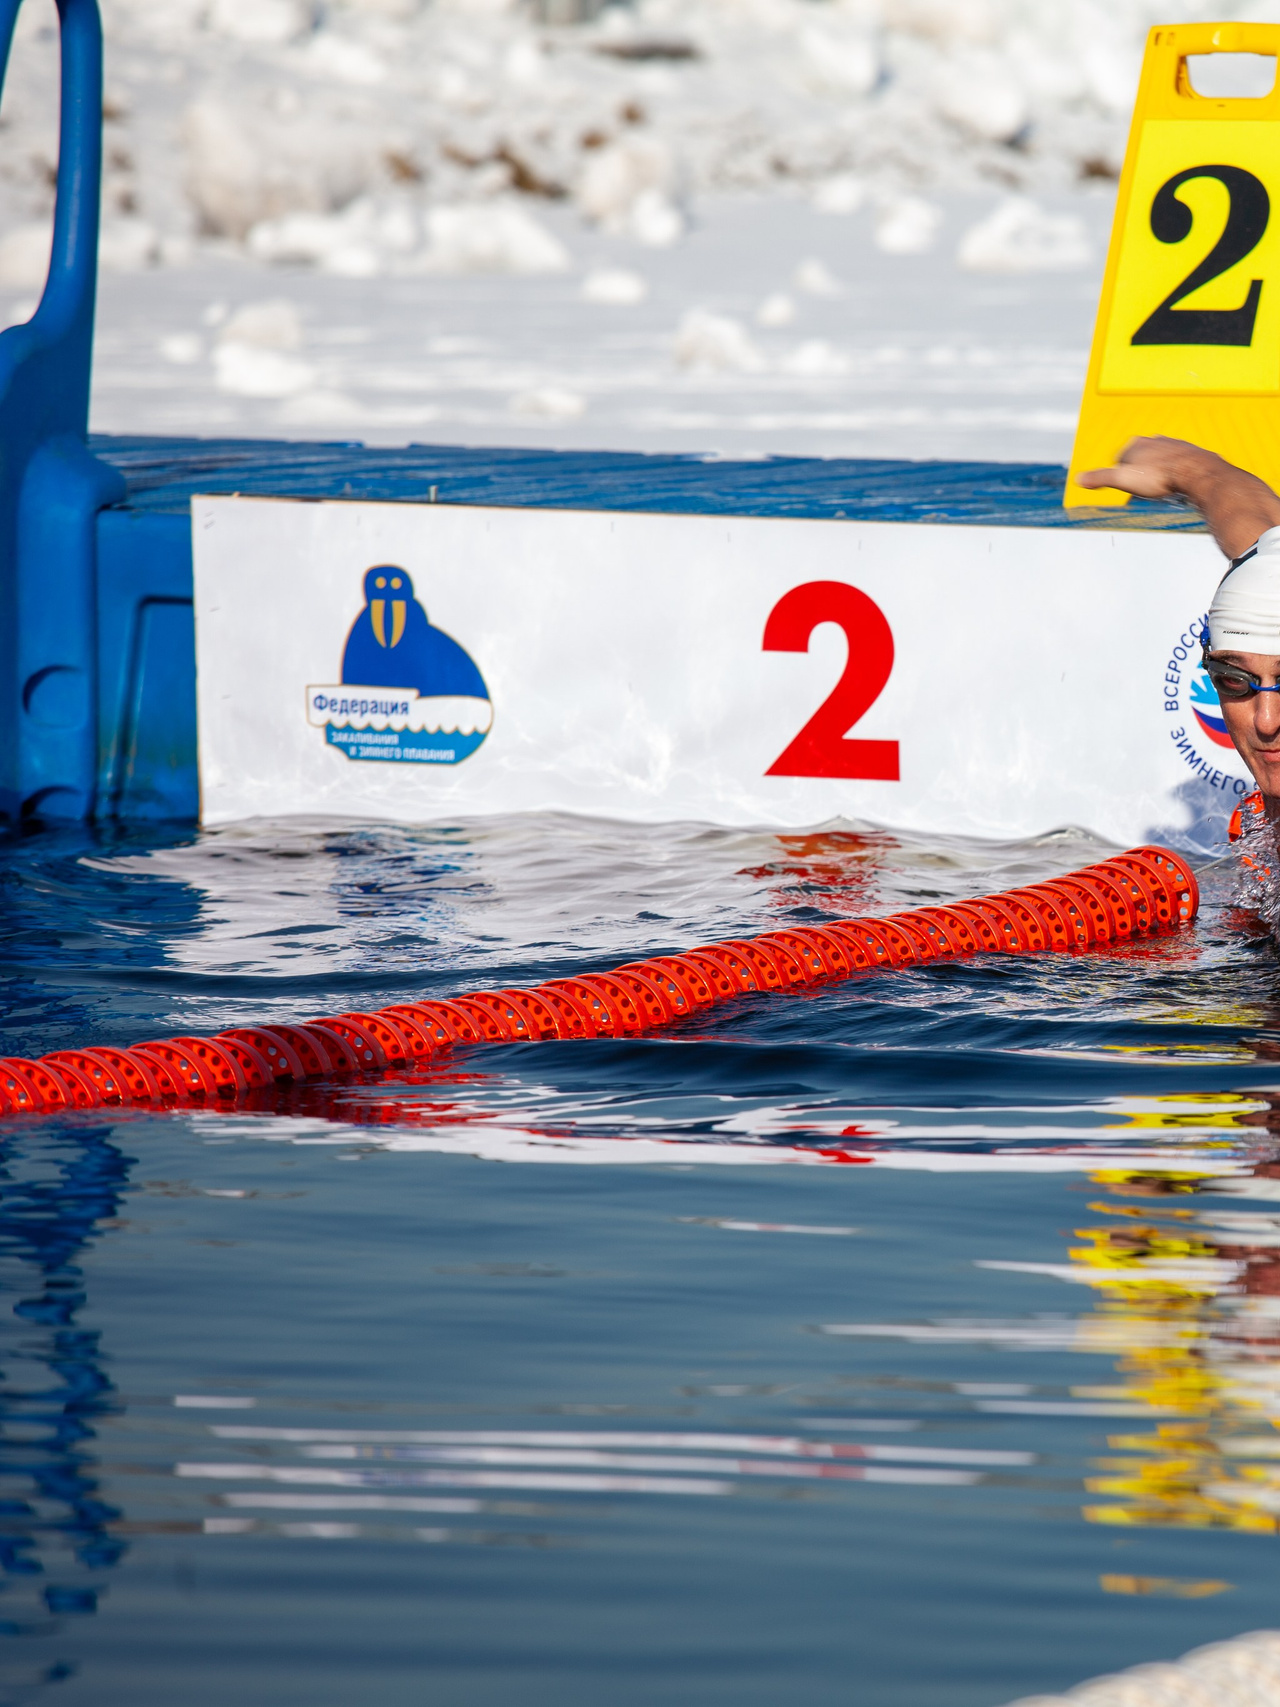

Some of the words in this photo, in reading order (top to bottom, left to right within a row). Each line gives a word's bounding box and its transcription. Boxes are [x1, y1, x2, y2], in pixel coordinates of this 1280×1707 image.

[1130, 165, 1271, 347] 2
[761, 580, 901, 782] 2
[313, 694, 410, 717] Федерация
[331, 731, 399, 745] ЗАКАЛИВАНИЯ
[359, 746, 402, 759] ЗИМНЕГО
[403, 748, 455, 760] ПЛАВАНИЯ
[1170, 726, 1247, 796] ЗИМНЕГО
